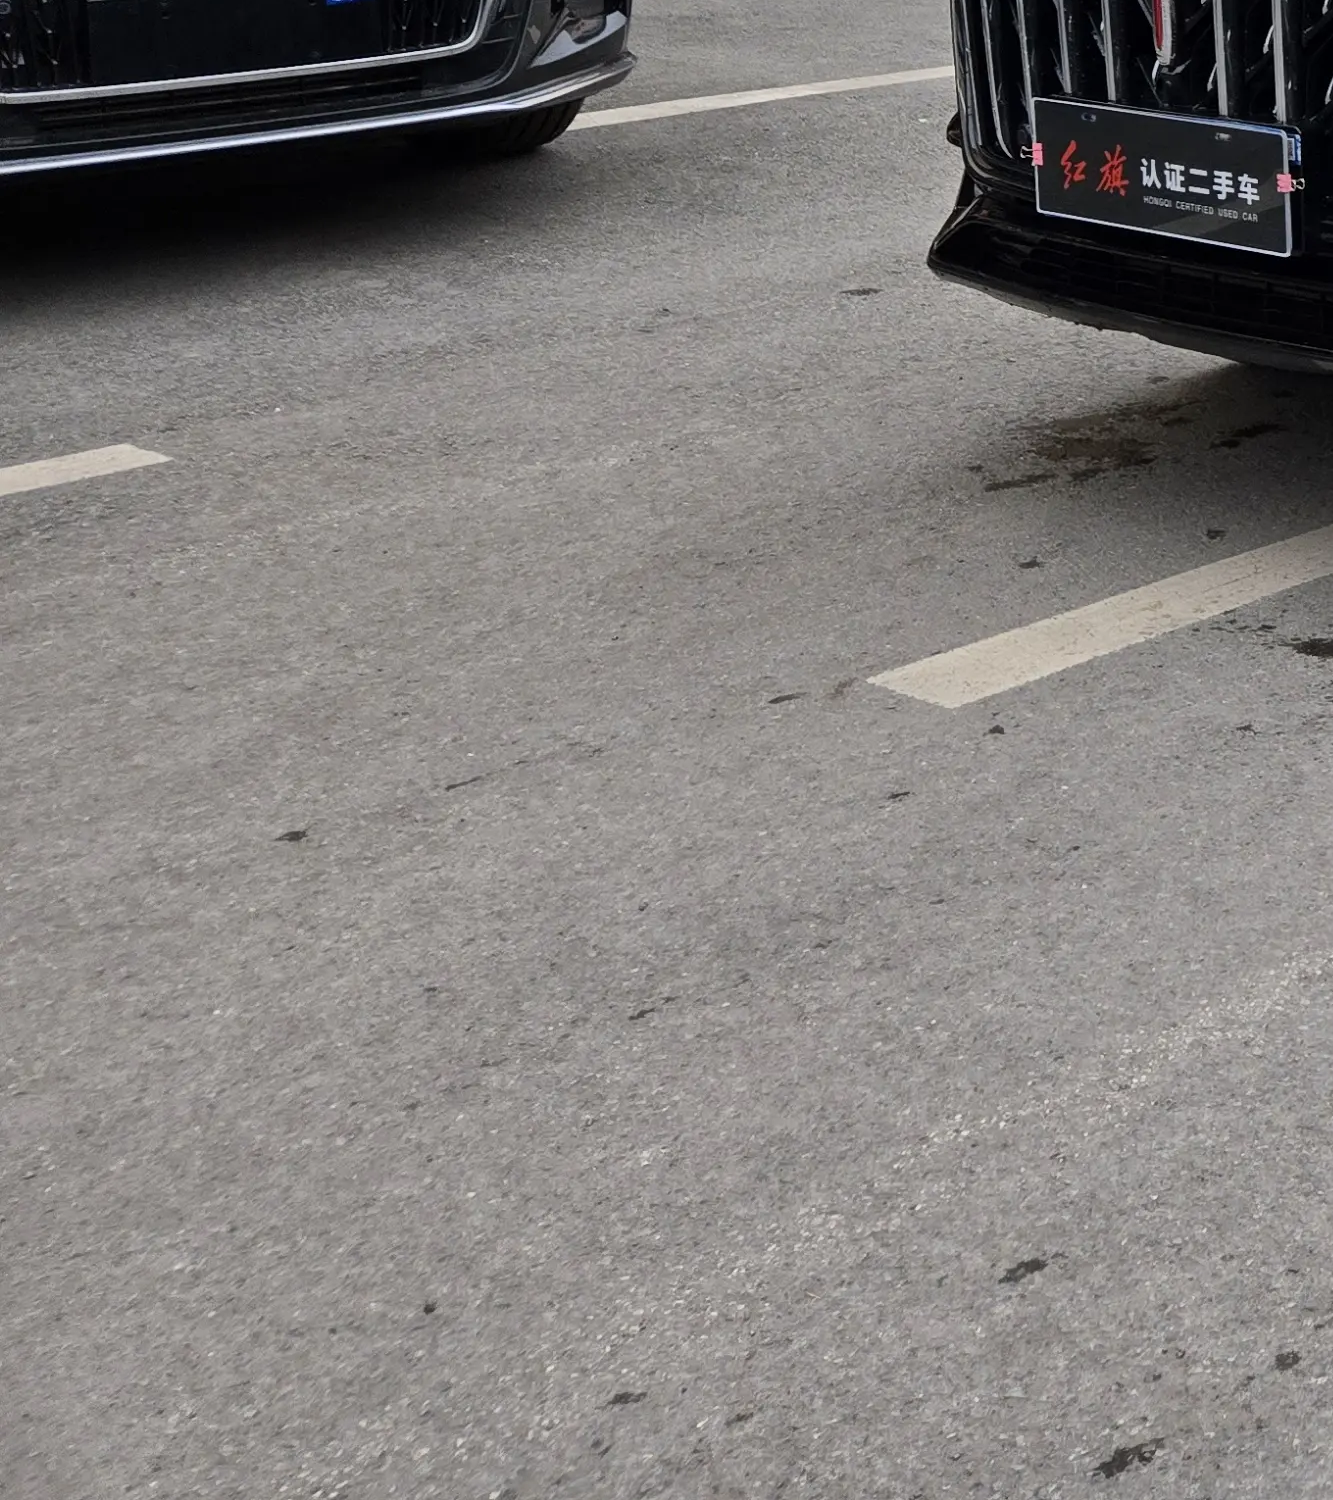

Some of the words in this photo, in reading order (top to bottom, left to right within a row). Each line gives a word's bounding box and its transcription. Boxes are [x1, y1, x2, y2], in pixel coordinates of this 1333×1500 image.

[1060, 139, 1131, 197] 红旗
[1139, 157, 1261, 206] 认证二手车
[1143, 195, 1173, 208] HONGQI
[1175, 200, 1214, 215] CERTIFIED
[1218, 207, 1239, 220] USED
[1242, 211, 1259, 223] CAR
